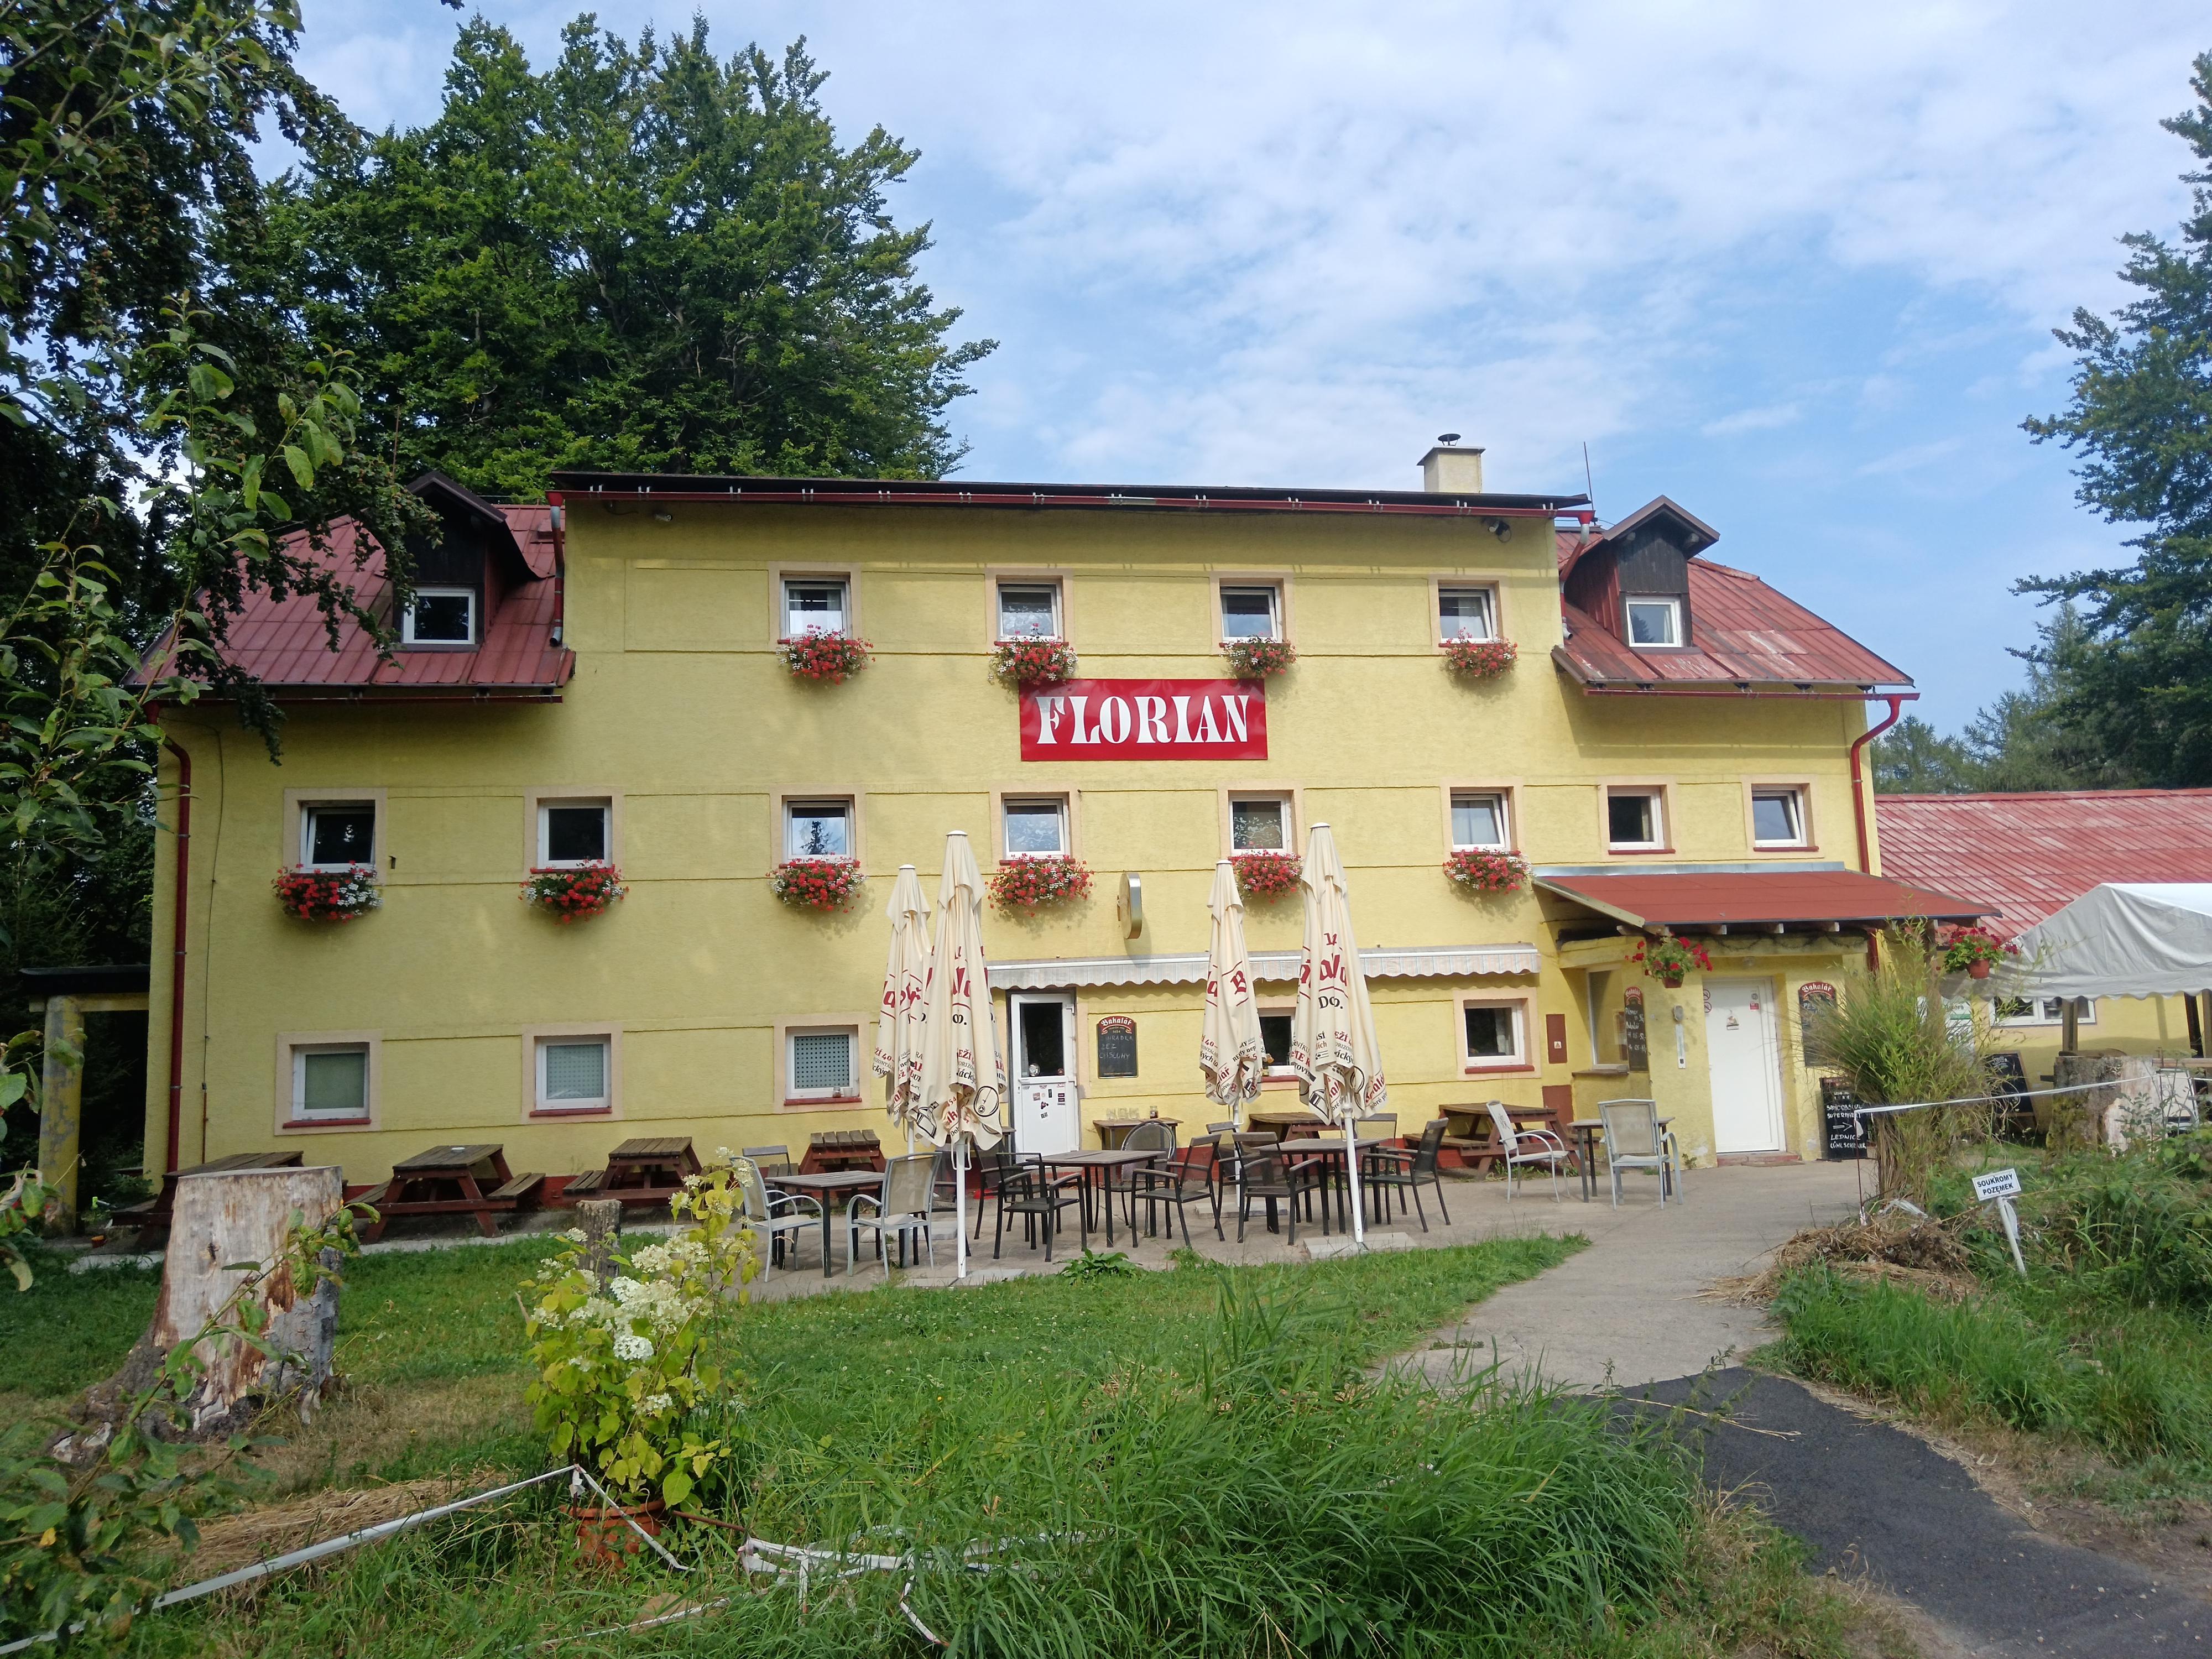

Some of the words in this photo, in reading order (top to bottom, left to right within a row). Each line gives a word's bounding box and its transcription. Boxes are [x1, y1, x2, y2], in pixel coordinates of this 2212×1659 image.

[1035, 695, 1250, 744] FLORIAN
[1802, 983, 1832, 993] Bakalář
[1101, 1017, 1132, 1026] Bakalář
[1983, 1183, 2014, 1195] POZEMEK
